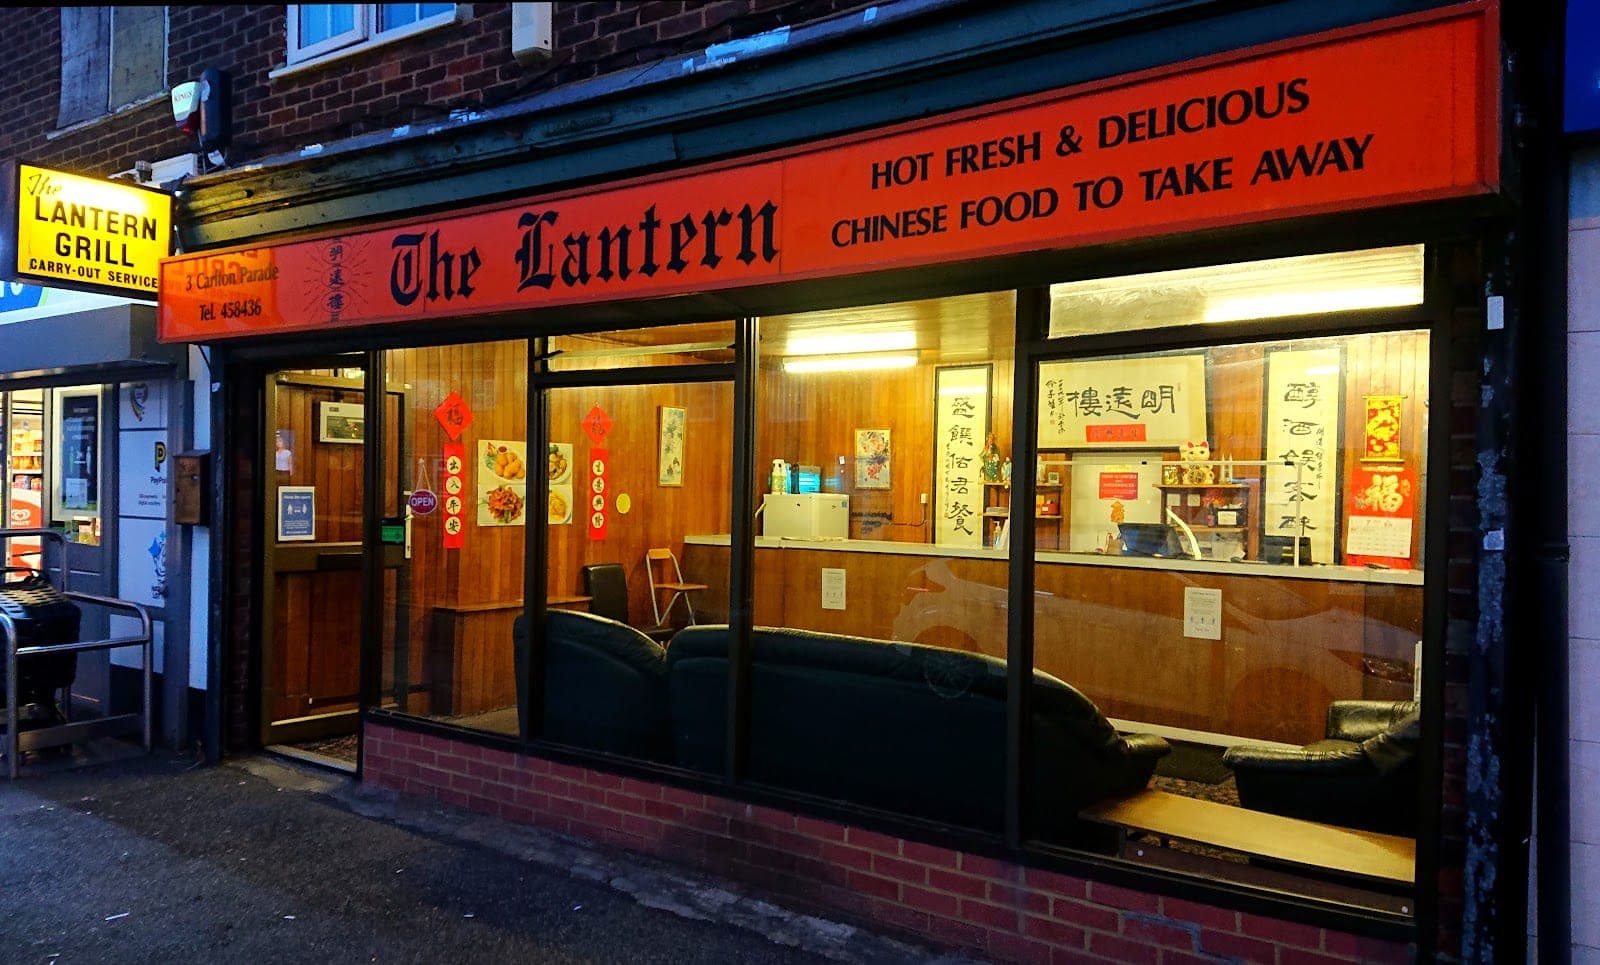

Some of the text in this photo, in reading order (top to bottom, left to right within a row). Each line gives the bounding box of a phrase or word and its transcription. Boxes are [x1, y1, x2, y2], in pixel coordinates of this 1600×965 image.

[871, 78, 1310, 190] HOT FRESH & DELICIOUS
[26, 173, 64, 197] The
[831, 134, 1375, 247] CHINESE FOOD TO TAKE AWAY
[35, 196, 157, 241] LANTERN
[55, 232, 135, 268] GRILL
[390, 199, 780, 307] The Lantern
[29, 258, 158, 289] CARRY-OUT SERVICE
[185, 274, 193, 292] 3
[240, 262, 279, 283] Parade
[199, 298, 262, 321] Tel. 458436
[411, 496, 434, 507] OPEN
[446, 458, 461, 534] 出入平安
[1365, 474, 1404, 513] 福
